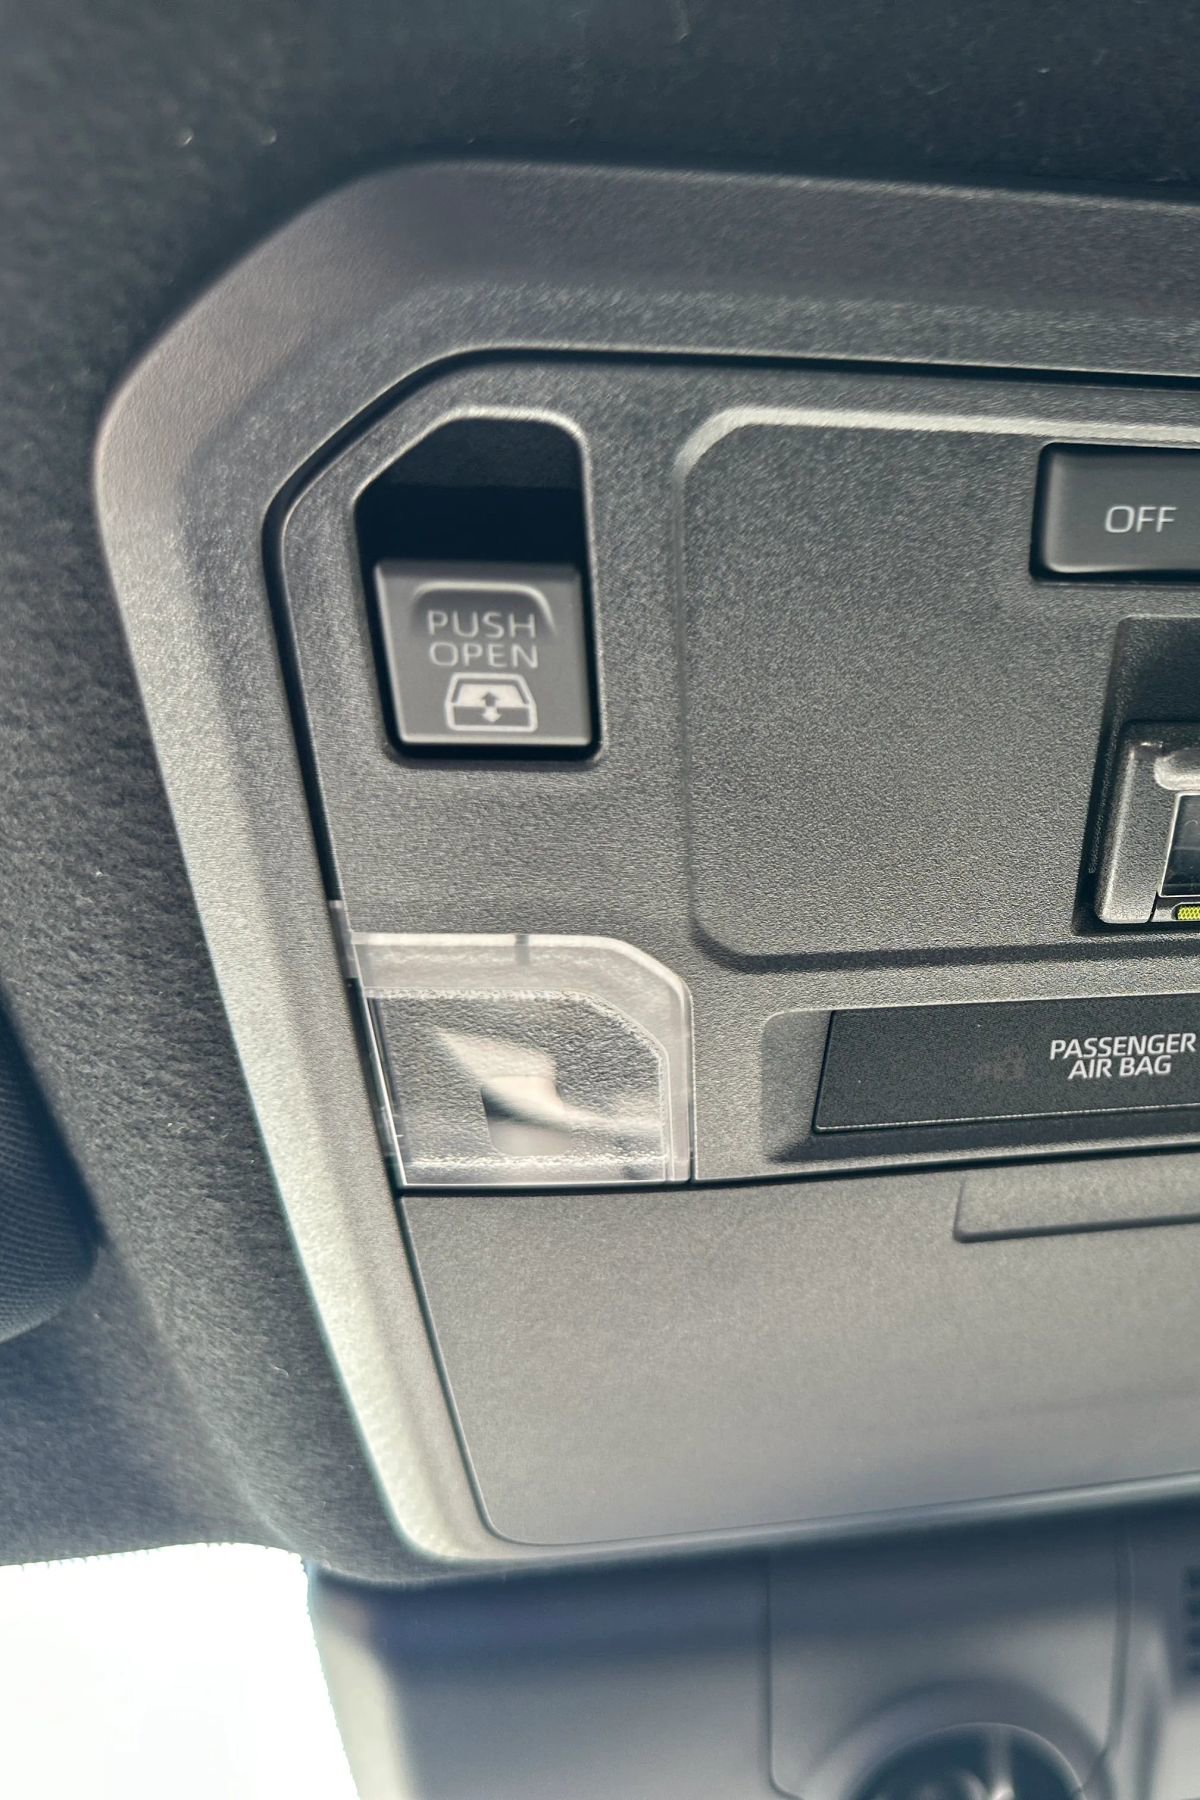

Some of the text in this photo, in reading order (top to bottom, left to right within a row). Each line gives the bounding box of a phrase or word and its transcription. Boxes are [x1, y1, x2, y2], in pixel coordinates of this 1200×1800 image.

[1104, 505, 1177, 534] OFF
[427, 610, 536, 639] PUSH
[429, 641, 539, 669] OPEN
[1049, 1032, 1197, 1060] PASSENGER
[1067, 1054, 1172, 1080] AIR BAG
